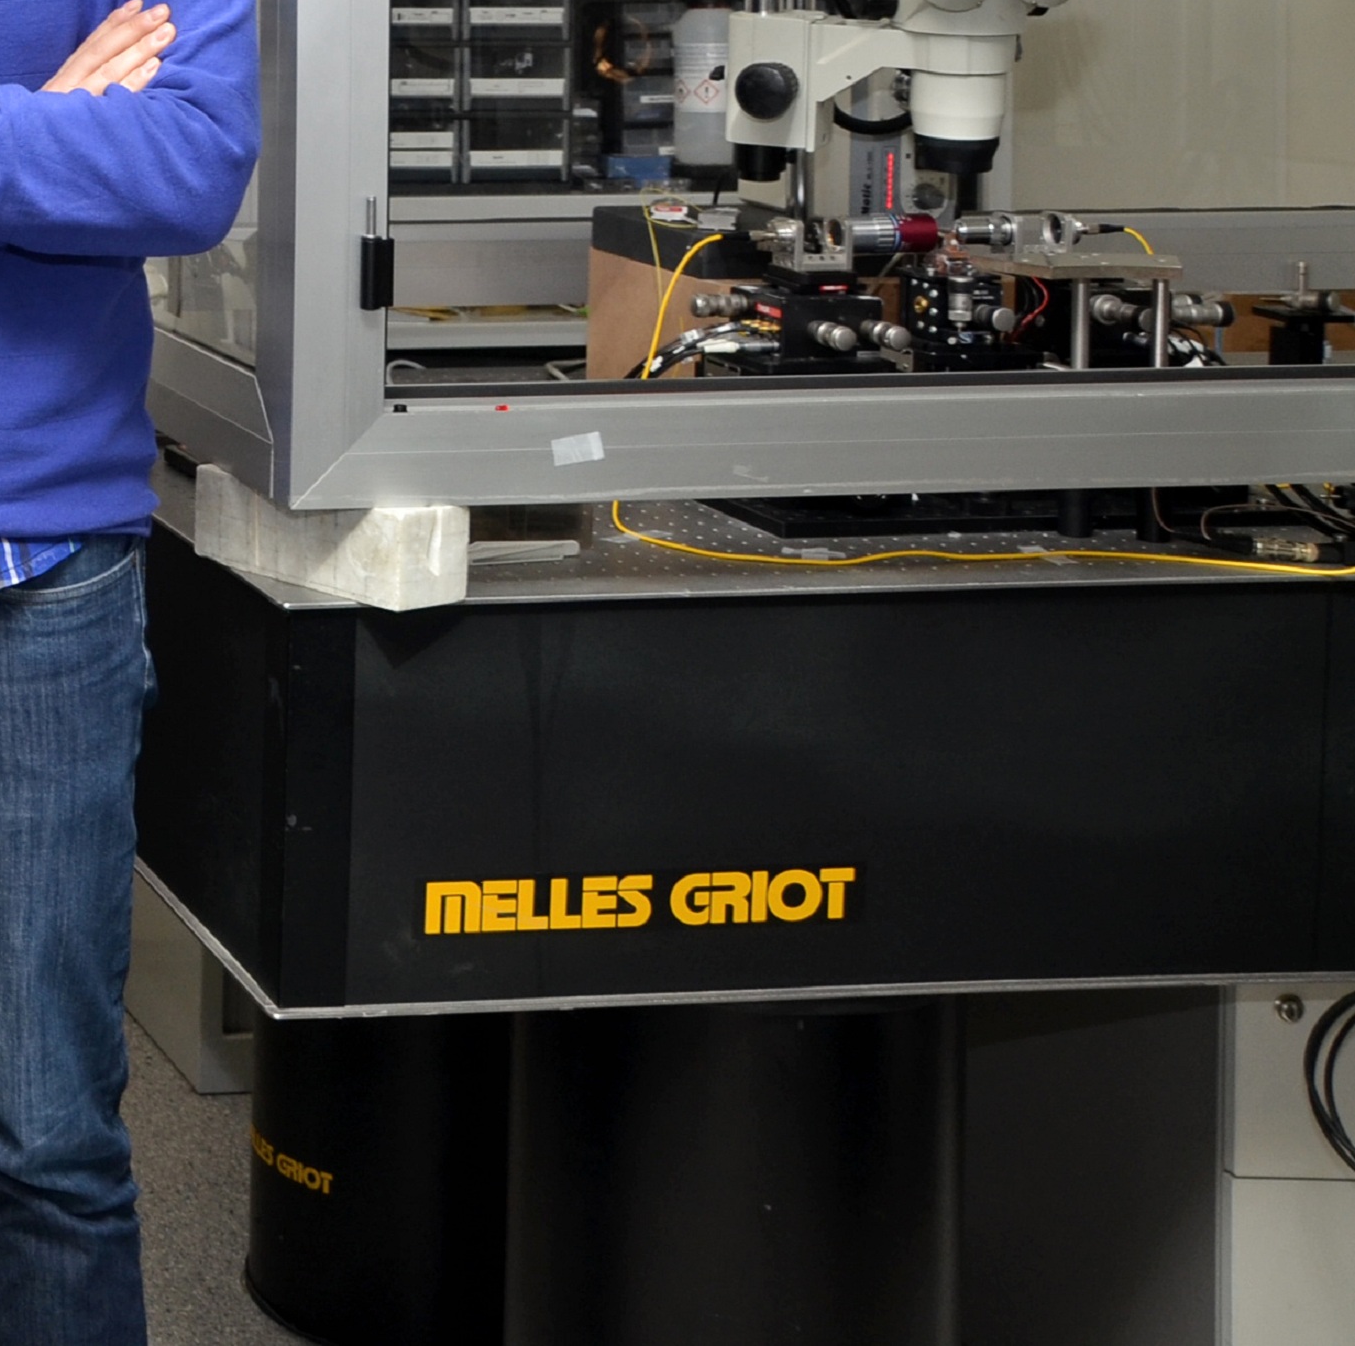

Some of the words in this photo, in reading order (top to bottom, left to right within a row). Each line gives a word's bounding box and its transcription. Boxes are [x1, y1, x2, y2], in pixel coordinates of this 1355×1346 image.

[425, 874, 653, 935] MELLES
[670, 867, 856, 926] GRIOT
[276, 1152, 333, 1194] GRIOT
